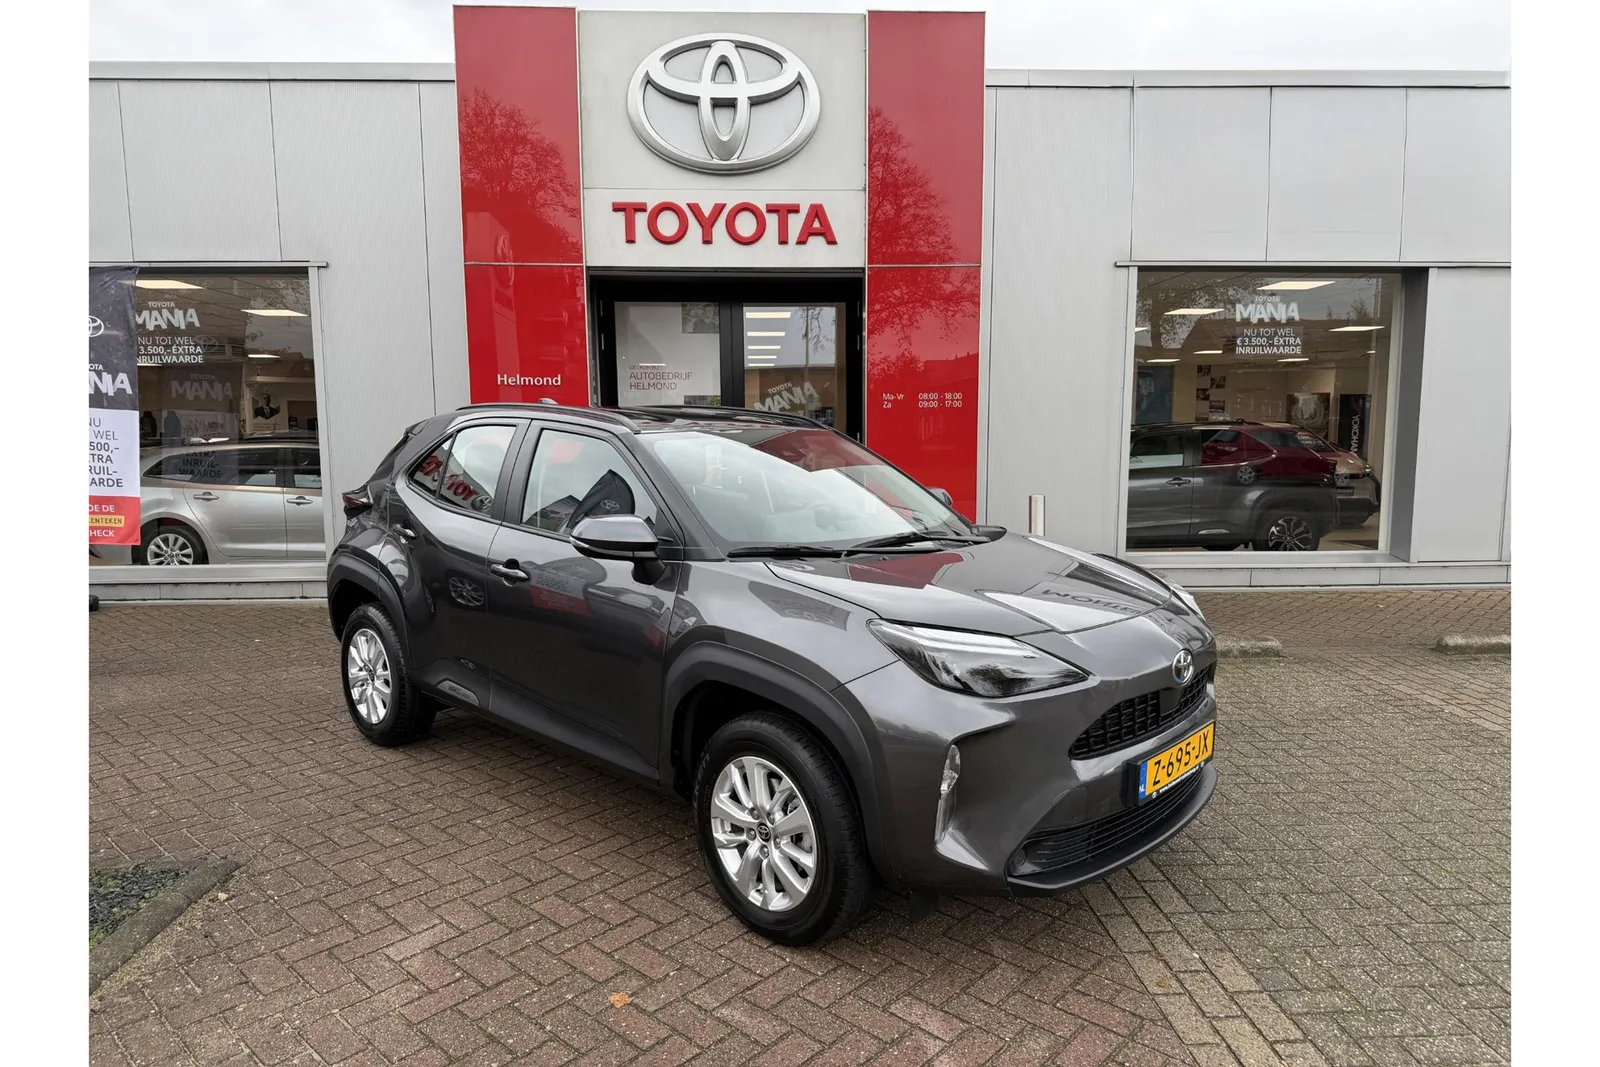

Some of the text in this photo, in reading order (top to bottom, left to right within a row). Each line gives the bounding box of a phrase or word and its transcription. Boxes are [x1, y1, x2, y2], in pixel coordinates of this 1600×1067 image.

[612, 201, 838, 245] TOYOTA
[1235, 302, 1300, 324] MANIA
[1243, 328, 1295, 337] NU TOT WEL
[137, 336, 195, 345] NU TOT WEL
[1235, 346, 1302, 354] INRUILWAARDE
[137, 355, 204, 364] NRUILWAARDE
[497, 373, 561, 386] Helmond
[629, 371, 693, 381] AUTOBEDRIJF
[88, 371, 133, 396] NIA
[629, 381, 678, 391] HELMOND
[767, 381, 793, 394] TOYOTA
[170, 380, 234, 401] MANIA
[918, 392, 939, 400] 08:00
[944, 392, 963, 400] 18:00
[918, 400, 939, 408] 09:00
[945, 400, 962, 408] 17:00
[93, 430, 119, 441] WEL
[88, 453, 113, 464] TRA
[102, 504, 116, 513] DE
[88, 517, 122, 525] ENTEKEN
[1152, 729, 1210, 787] Z-695-JX
[1138, 783, 1146, 794] NL
